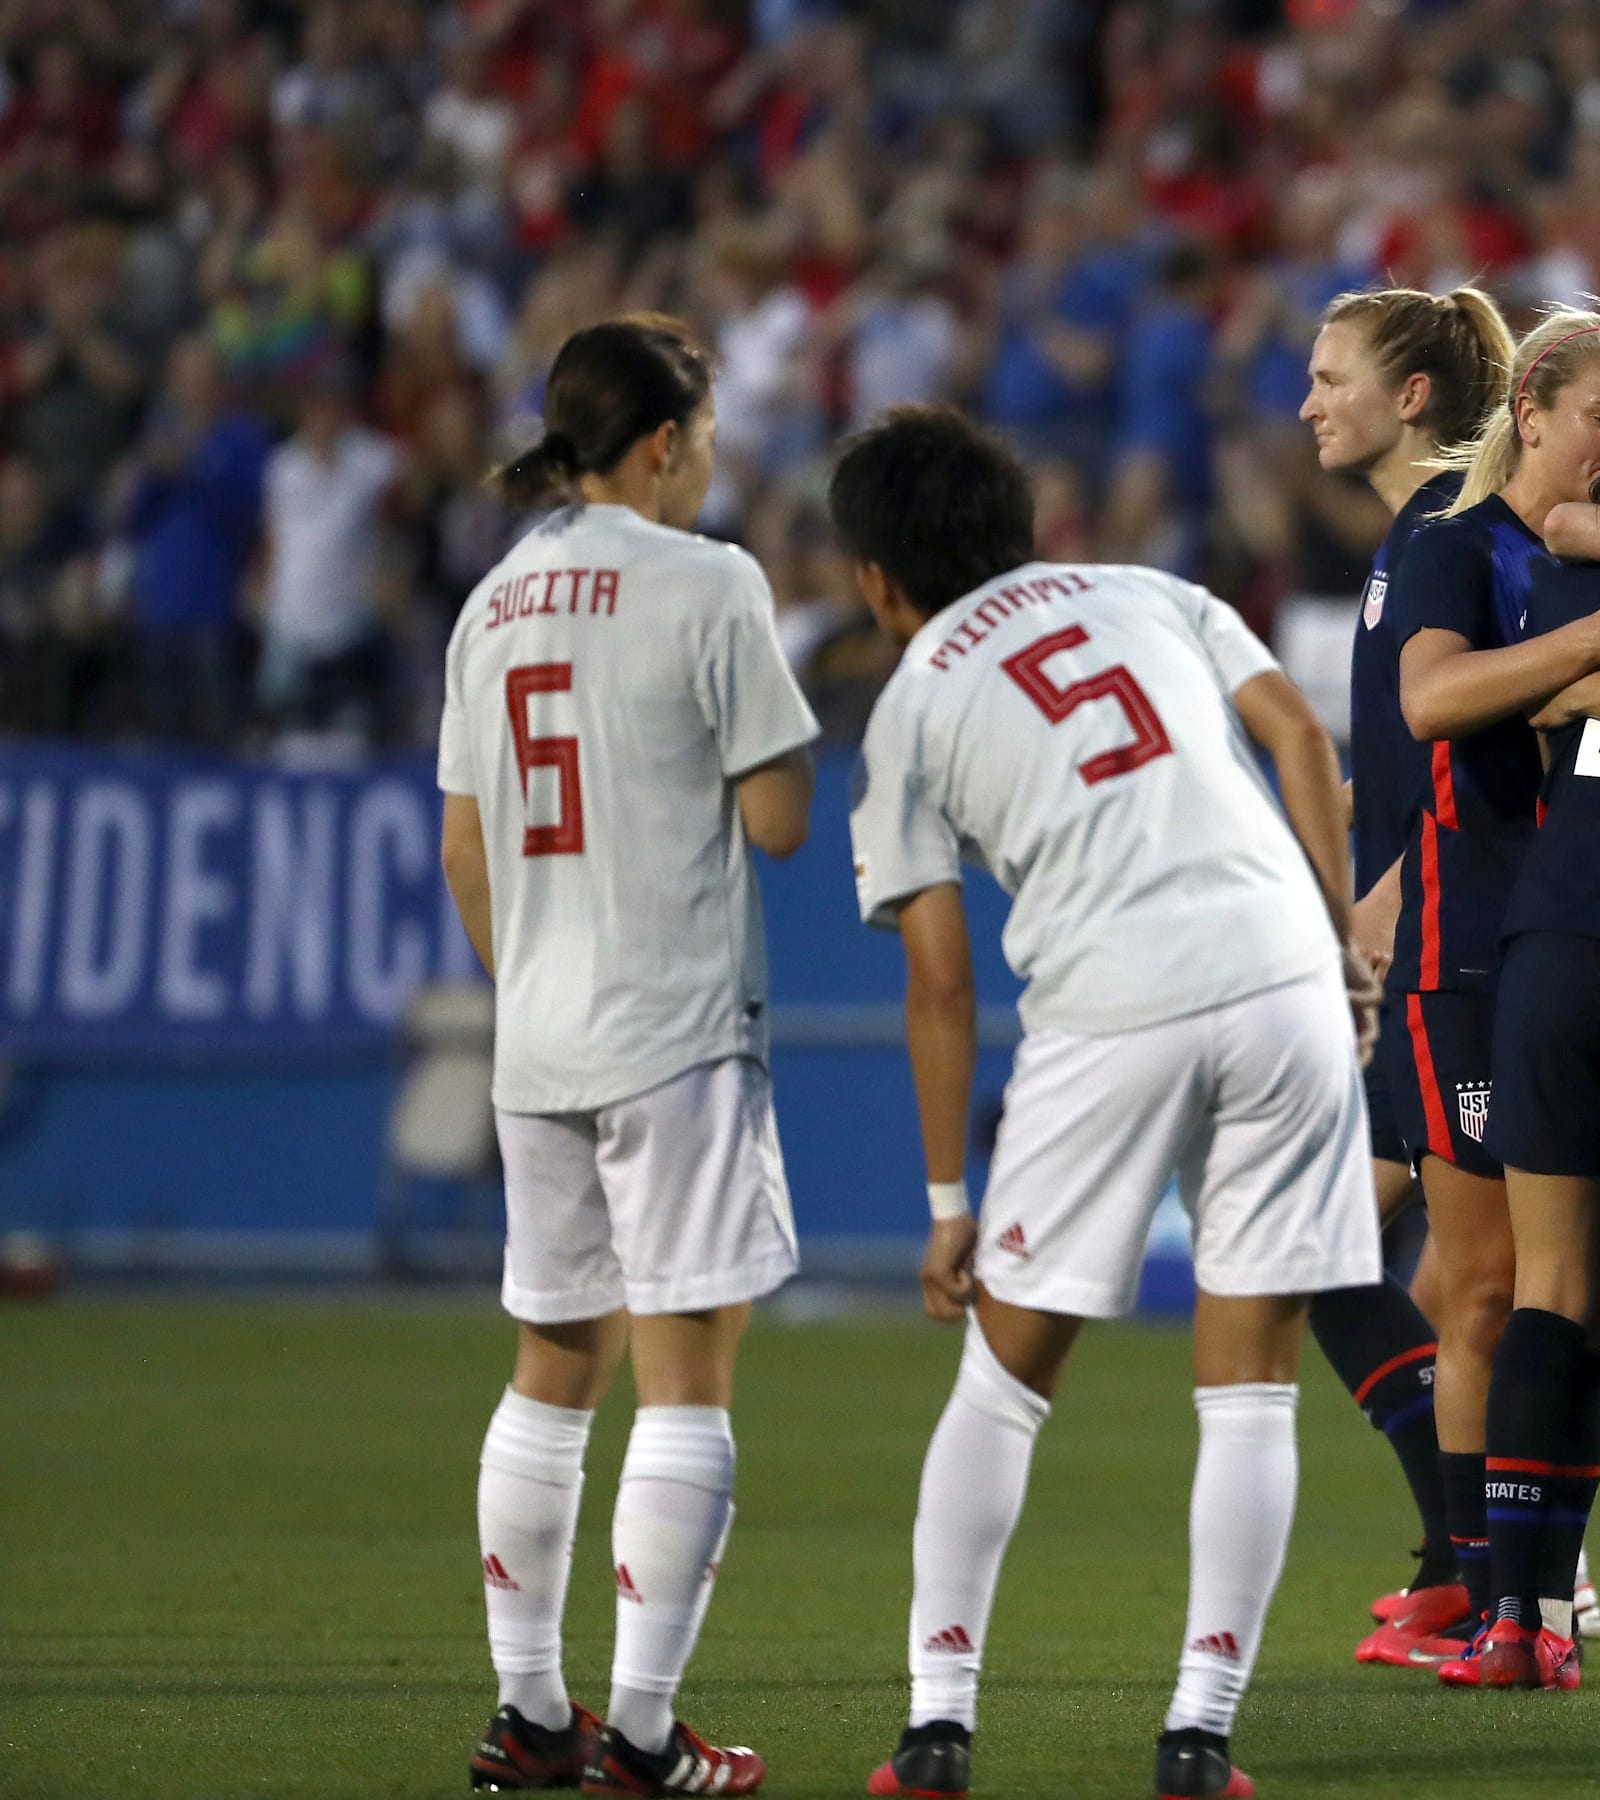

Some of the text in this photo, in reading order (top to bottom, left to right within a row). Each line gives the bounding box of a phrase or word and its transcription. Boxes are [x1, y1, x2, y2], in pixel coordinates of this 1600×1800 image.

[485, 567, 621, 630] SUGITA
[929, 572, 1096, 671] MINAMI
[505, 661, 584, 857] 6
[999, 622, 1175, 788] 5
